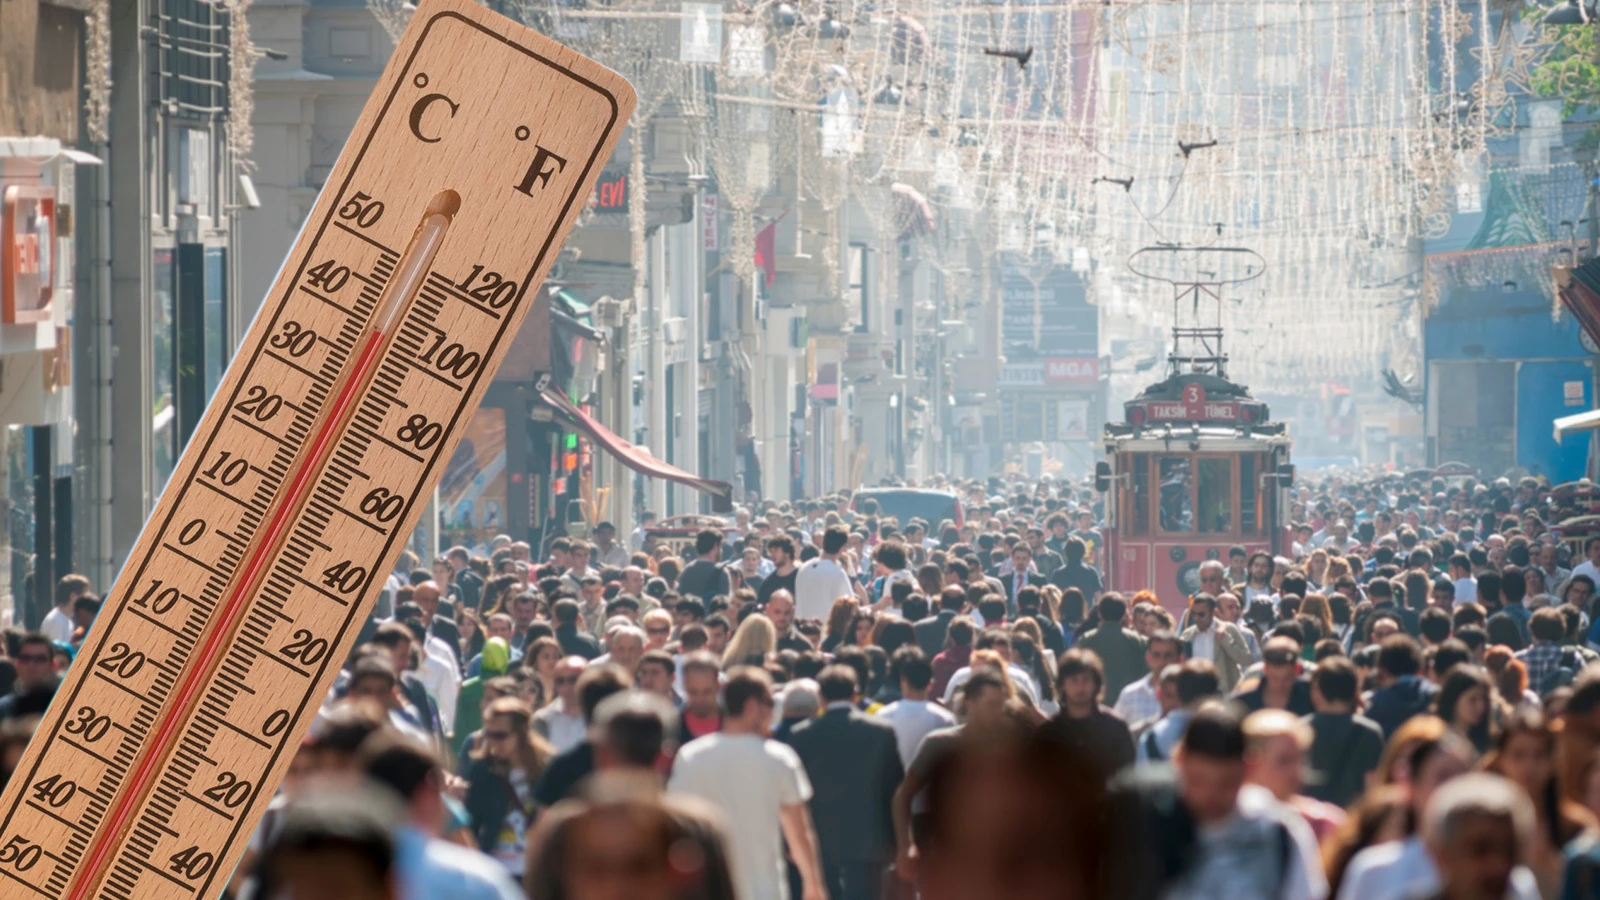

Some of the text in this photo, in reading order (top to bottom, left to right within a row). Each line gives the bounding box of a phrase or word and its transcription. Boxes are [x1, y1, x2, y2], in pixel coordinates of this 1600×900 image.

[339, 191, 385, 228] 50
[306, 259, 350, 294] 40
[455, 264, 518, 309] 120
[270, 320, 317, 358] 30
[418, 334, 481, 380] 100
[1049, 361, 1094, 378] MGA
[234, 385, 283, 422] 20
[1188, 387, 1199, 403] 3
[396, 414, 443, 451] 80
[202, 451, 249, 486] 10
[359, 487, 405, 523] 60
[178, 518, 207, 546] 0
[323, 560, 366, 595] 40
[133, 579, 180, 615] 10
[97, 642, 146, 679] 20
[279, 629, 329, 666] 20
[65, 706, 112, 743] 30
[261, 709, 290, 737] 0
[33, 774, 77, 808] 40
[204, 771, 252, 808] 20
[0, 835, 43, 872] 50
[169, 845, 214, 880] 40
